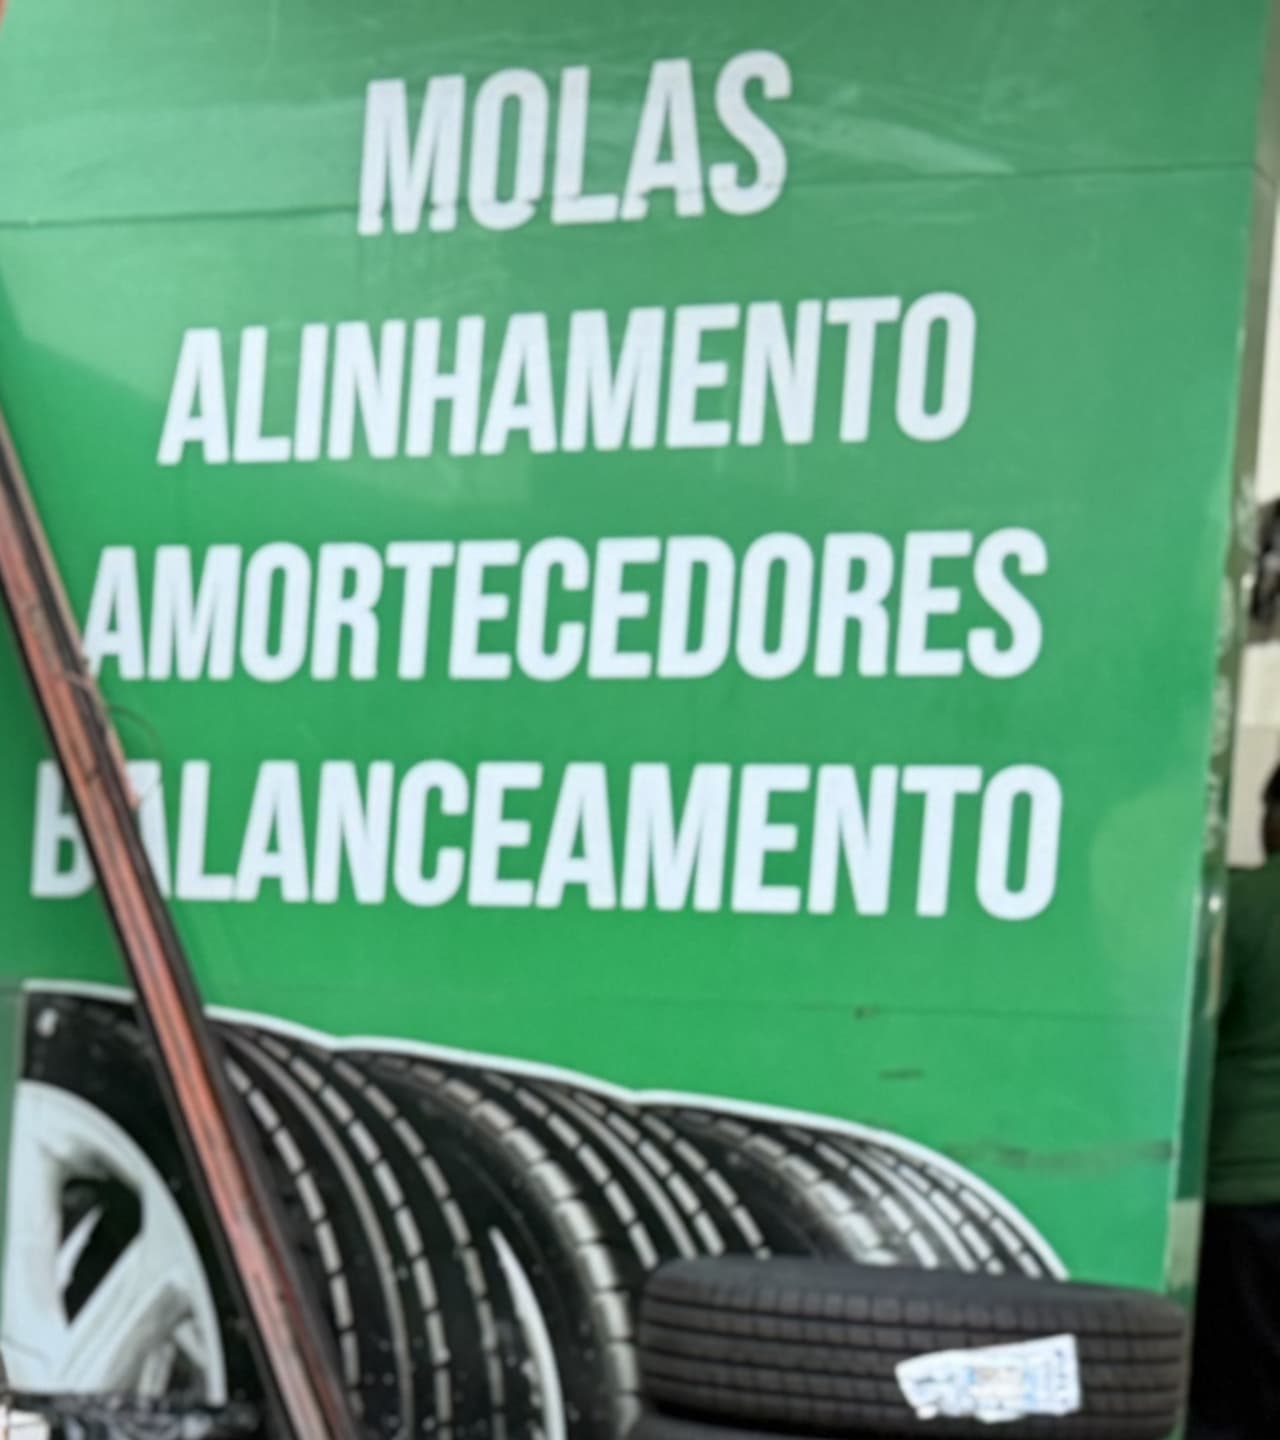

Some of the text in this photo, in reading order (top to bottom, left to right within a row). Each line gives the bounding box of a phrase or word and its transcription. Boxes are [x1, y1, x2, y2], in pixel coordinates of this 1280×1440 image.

[356, 50, 792, 237] MOLAS
[157, 292, 977, 465] ALINHAMENTO
[80, 527, 1048, 682] AMORTECEDORES
